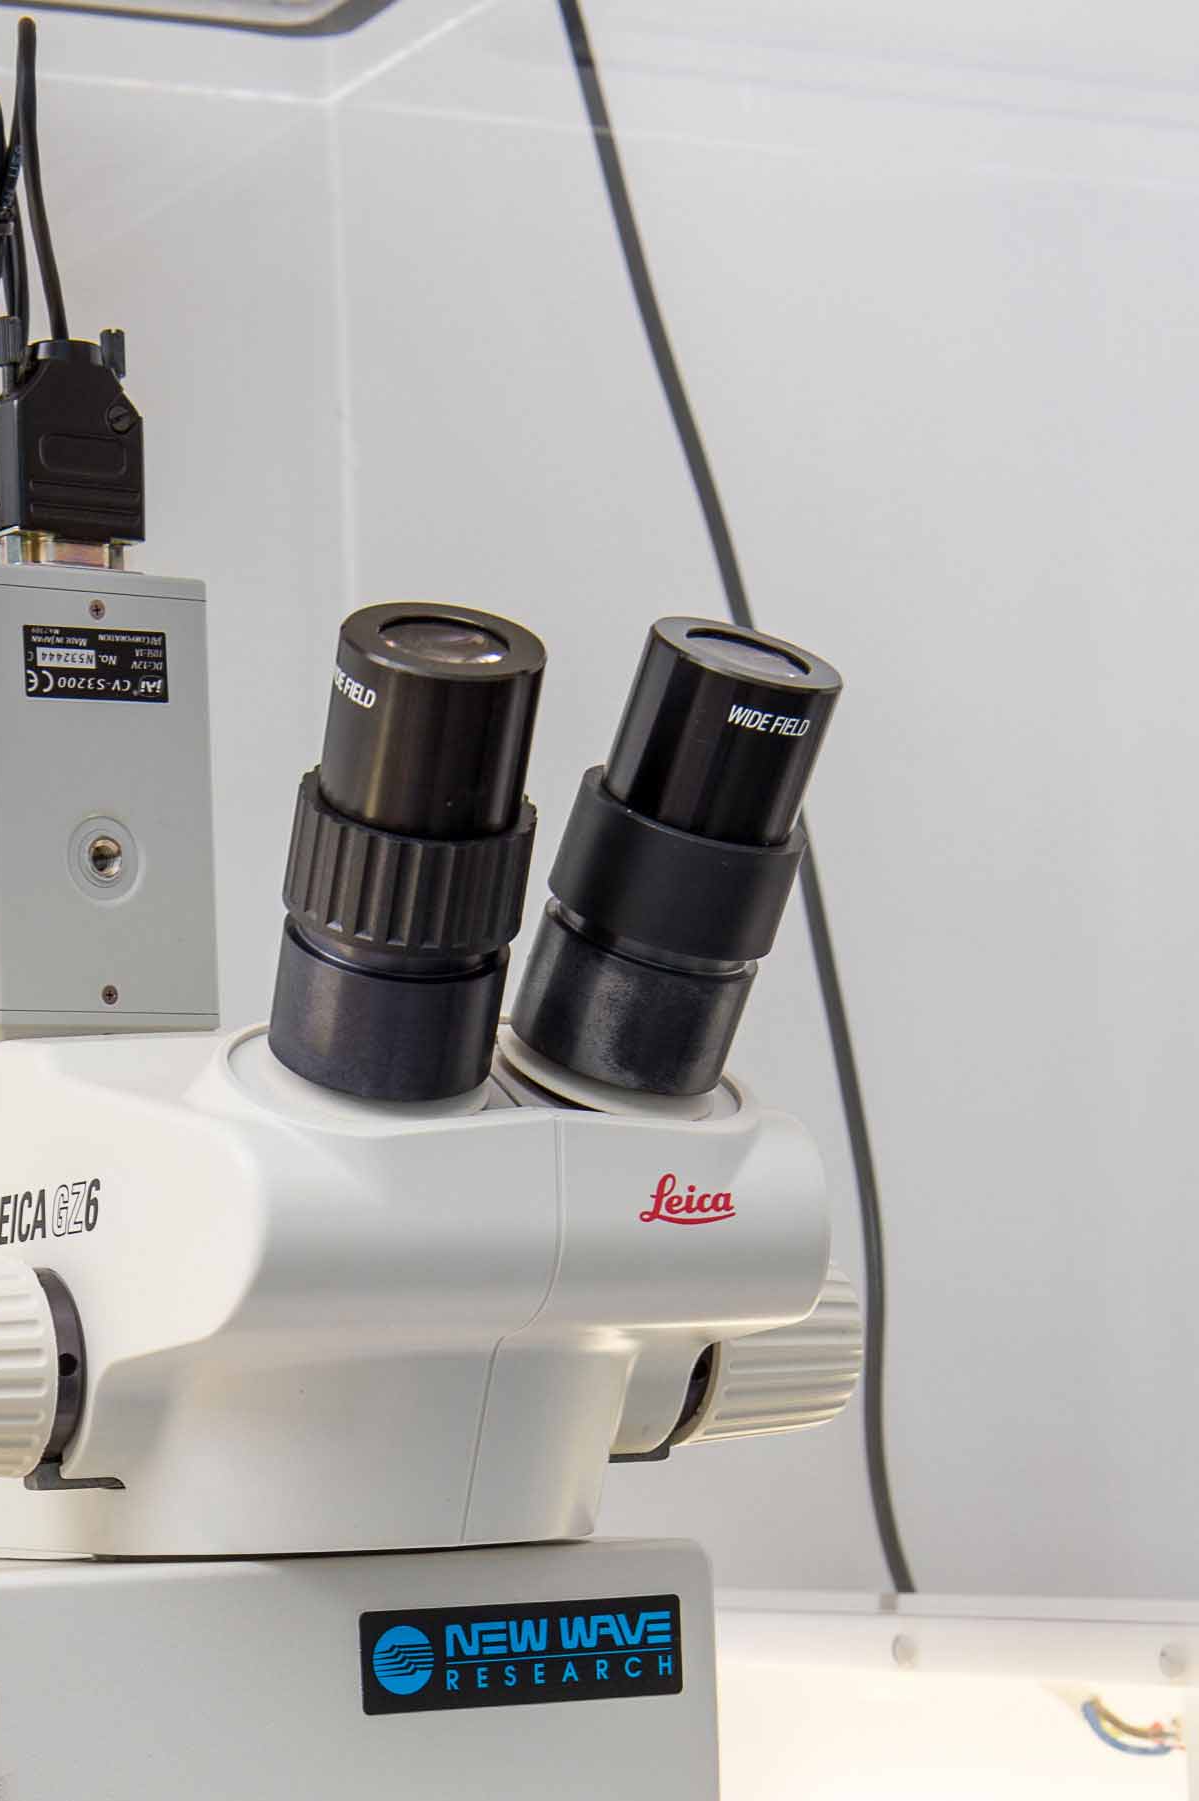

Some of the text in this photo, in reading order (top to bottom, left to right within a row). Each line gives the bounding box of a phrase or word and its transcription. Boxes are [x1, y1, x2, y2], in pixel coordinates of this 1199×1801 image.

[57, 676, 131, 692] CV-S3200
[343, 677, 376, 709] FIELD
[727, 704, 811, 737] WIDE FIELD
[51, 1178, 101, 1238] GZ6
[639, 1172, 737, 1226] Leica
[445, 1610, 672, 1657] NEW WAVE
[445, 1654, 674, 1691] RESEARCH
